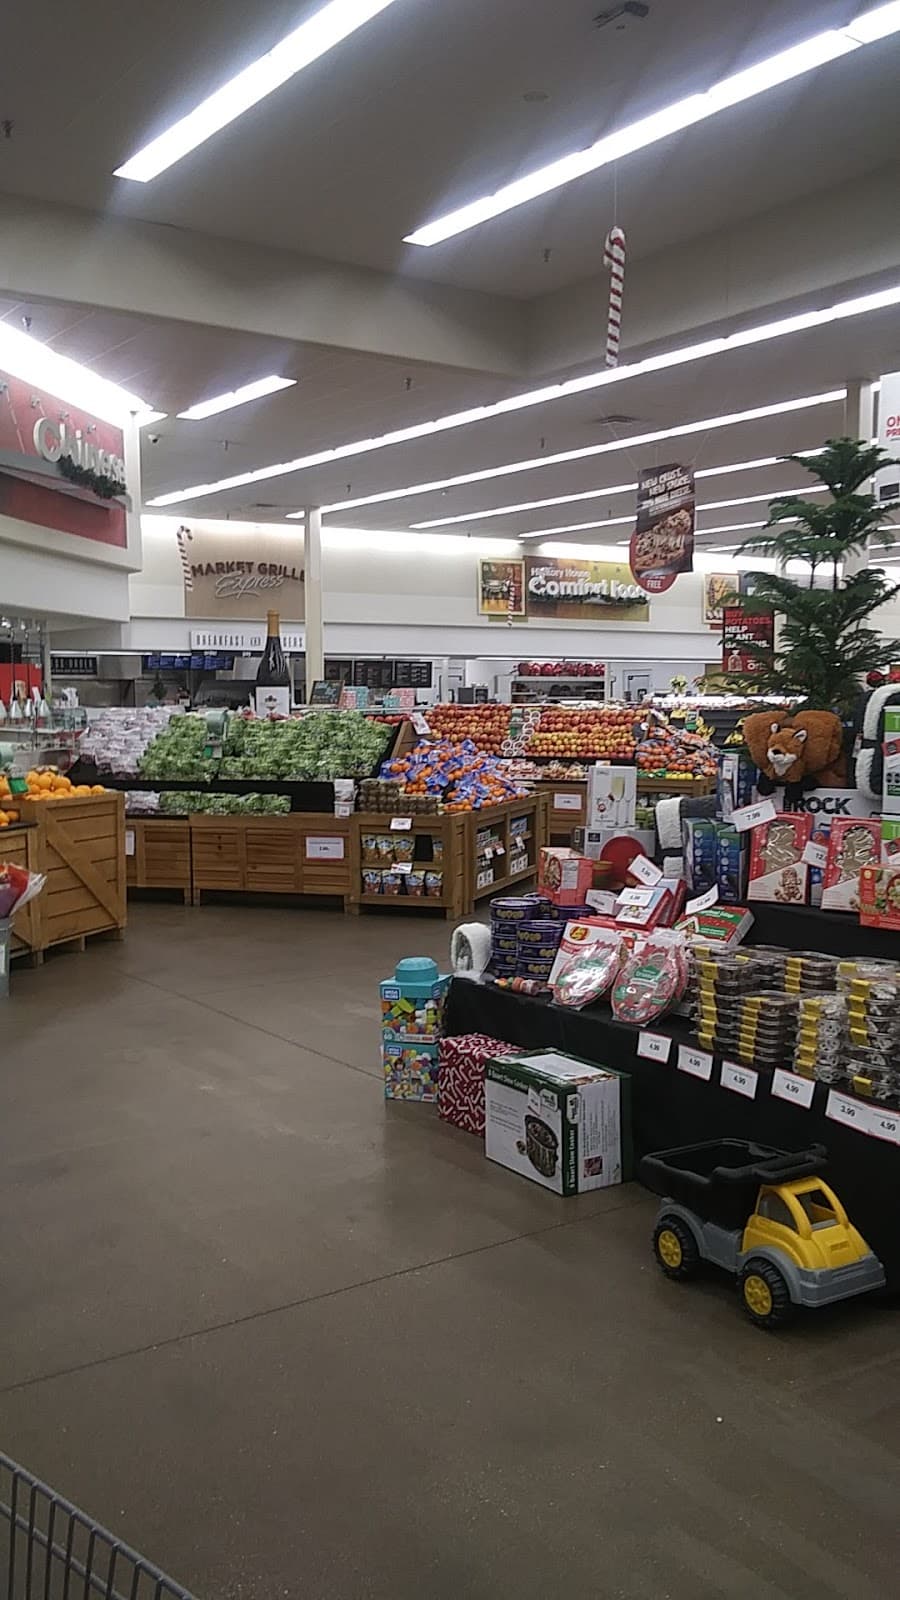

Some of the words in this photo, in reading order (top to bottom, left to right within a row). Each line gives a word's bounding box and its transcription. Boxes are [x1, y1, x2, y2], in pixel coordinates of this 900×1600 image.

[190, 561, 254, 577] MARKET
[215, 570, 284, 599] Express
[725, 625, 748, 633] HELP
